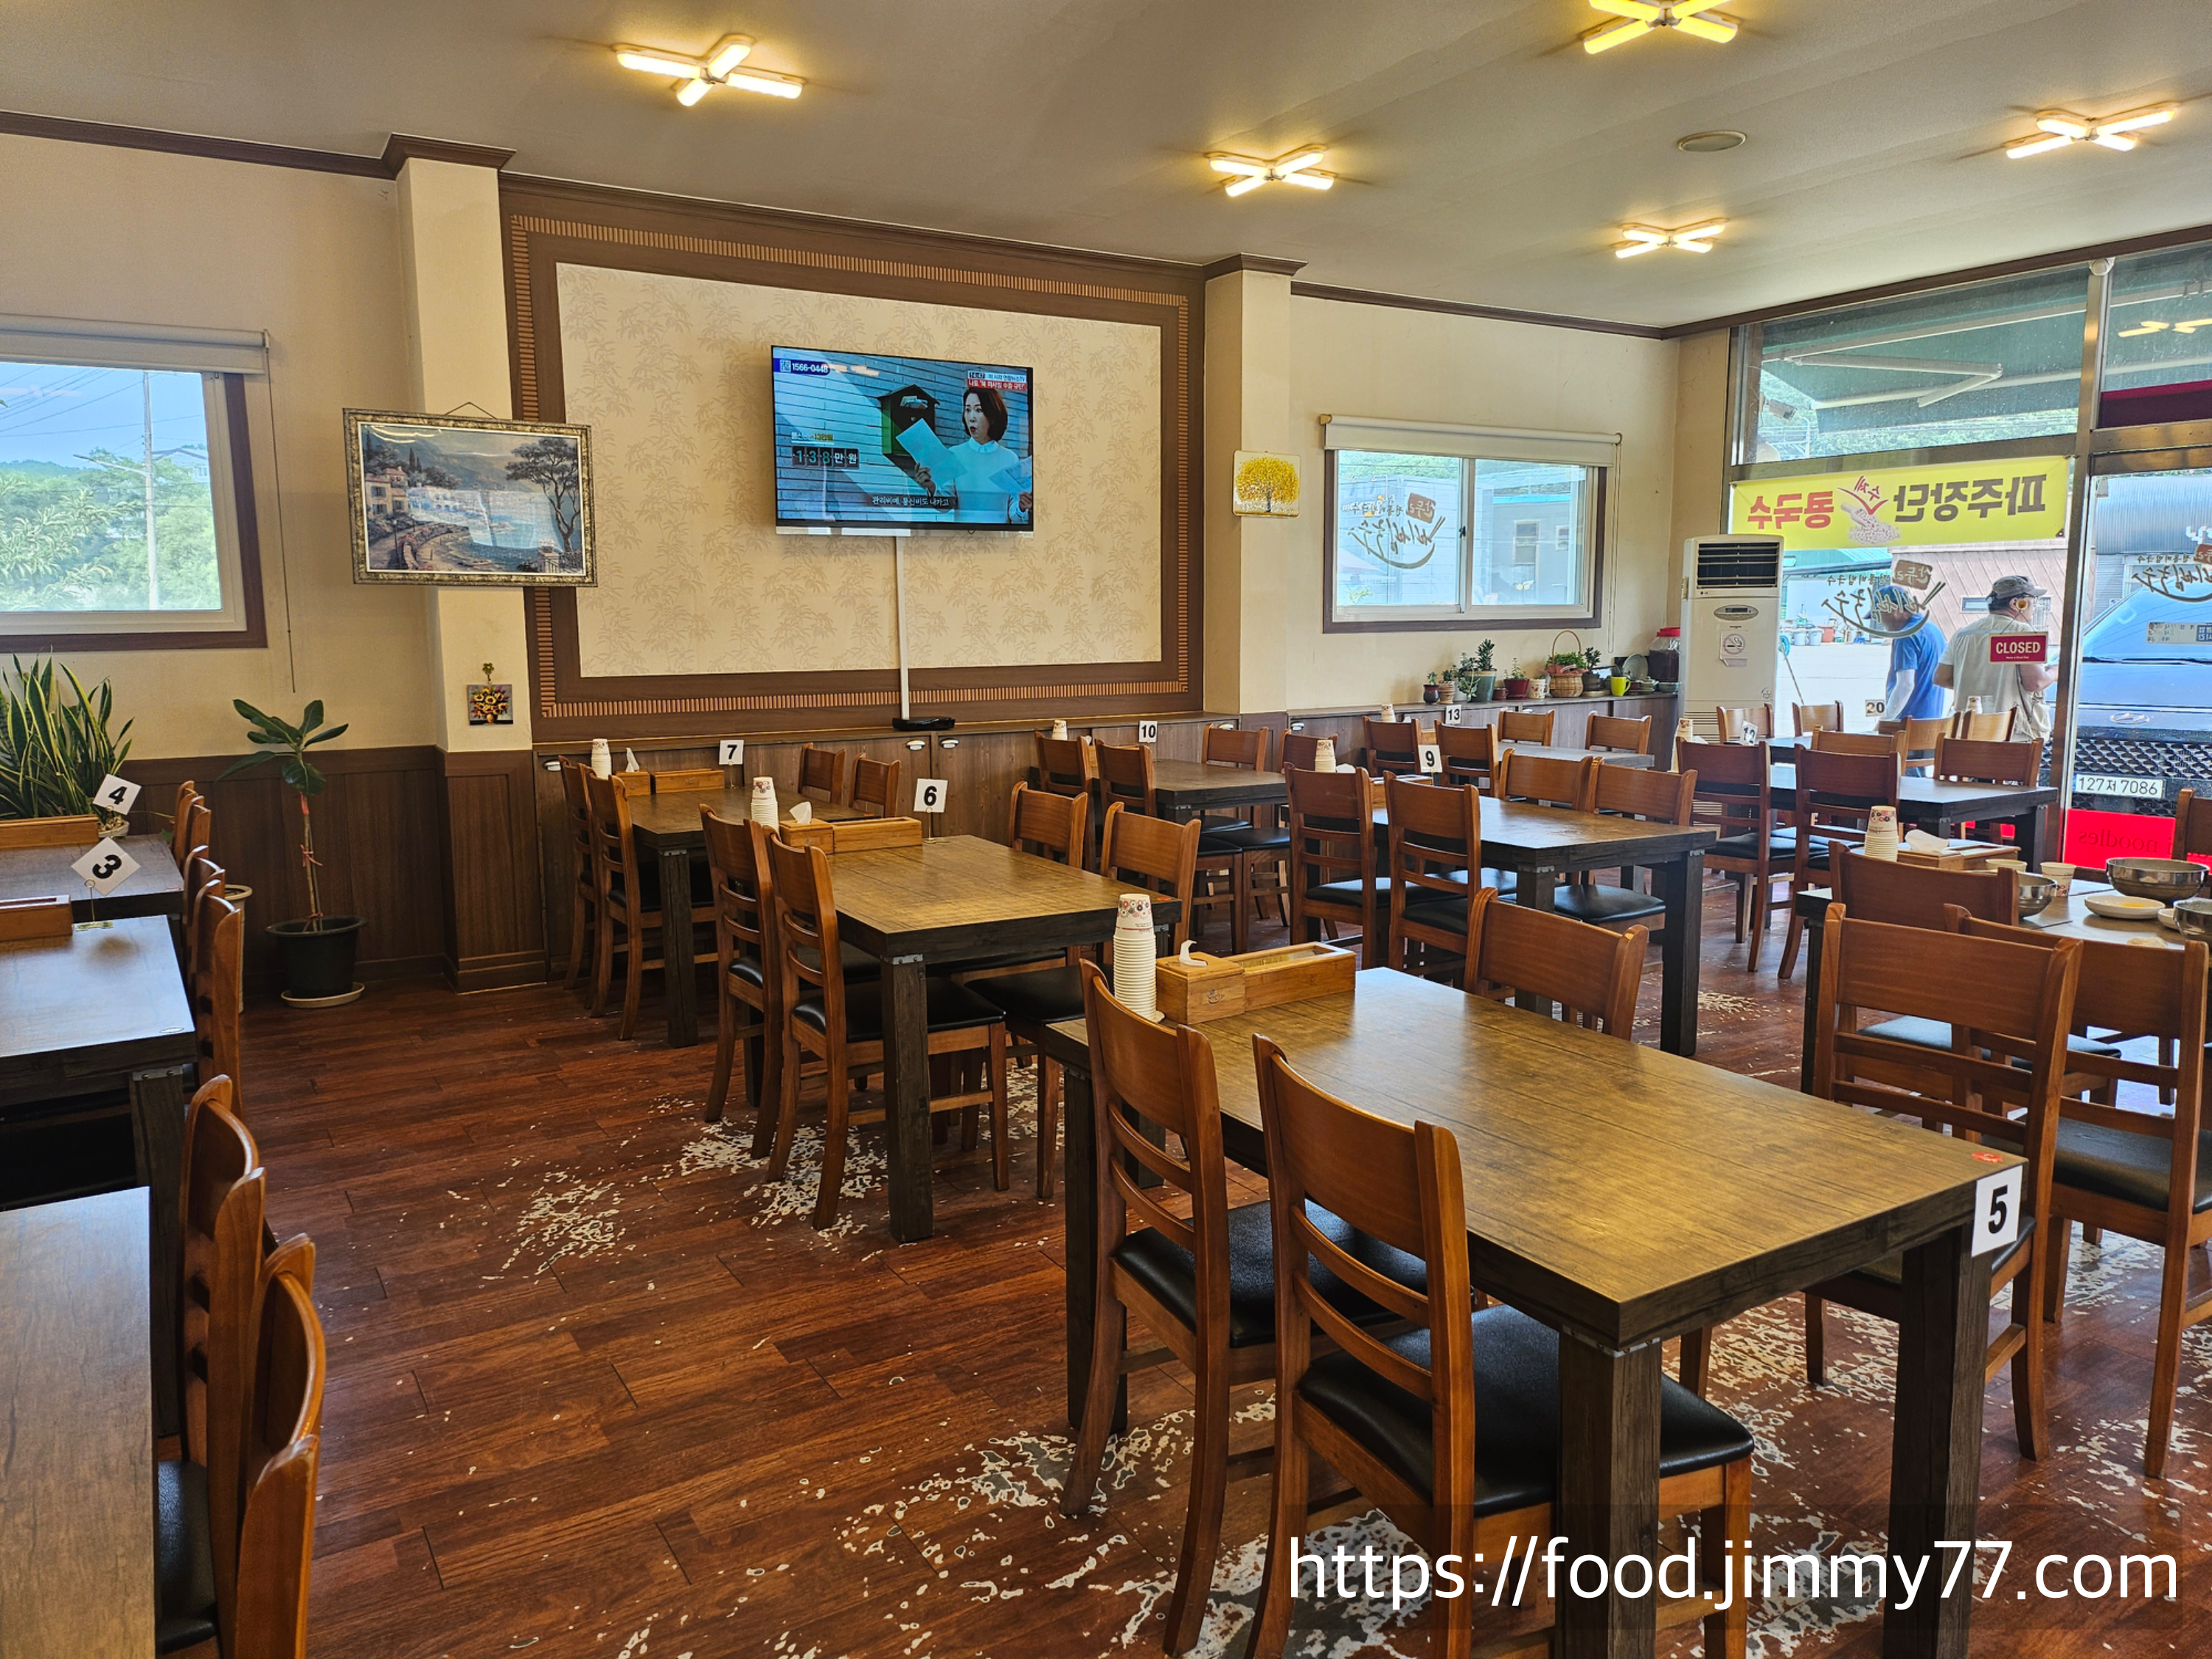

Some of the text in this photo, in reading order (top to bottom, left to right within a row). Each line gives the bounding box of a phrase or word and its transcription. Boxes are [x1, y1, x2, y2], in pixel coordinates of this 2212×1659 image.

[792, 363, 828, 373] 1566-0448
[930, 498, 950, 507] 나가고
[1995, 641, 2041, 654] CLOSED
[1447, 709, 1460, 720] 13
[1865, 702, 1885, 714] 20
[1141, 725, 1156, 738] 10
[727, 745, 737, 759] 7
[1425, 750, 1435, 767] 9
[2079, 776, 2157, 796] 127저 7086
[108, 785, 128, 805] 4
[923, 786, 937, 807] 6
[91, 855, 122, 879] 3
[1989, 1184, 2008, 1234] 5
